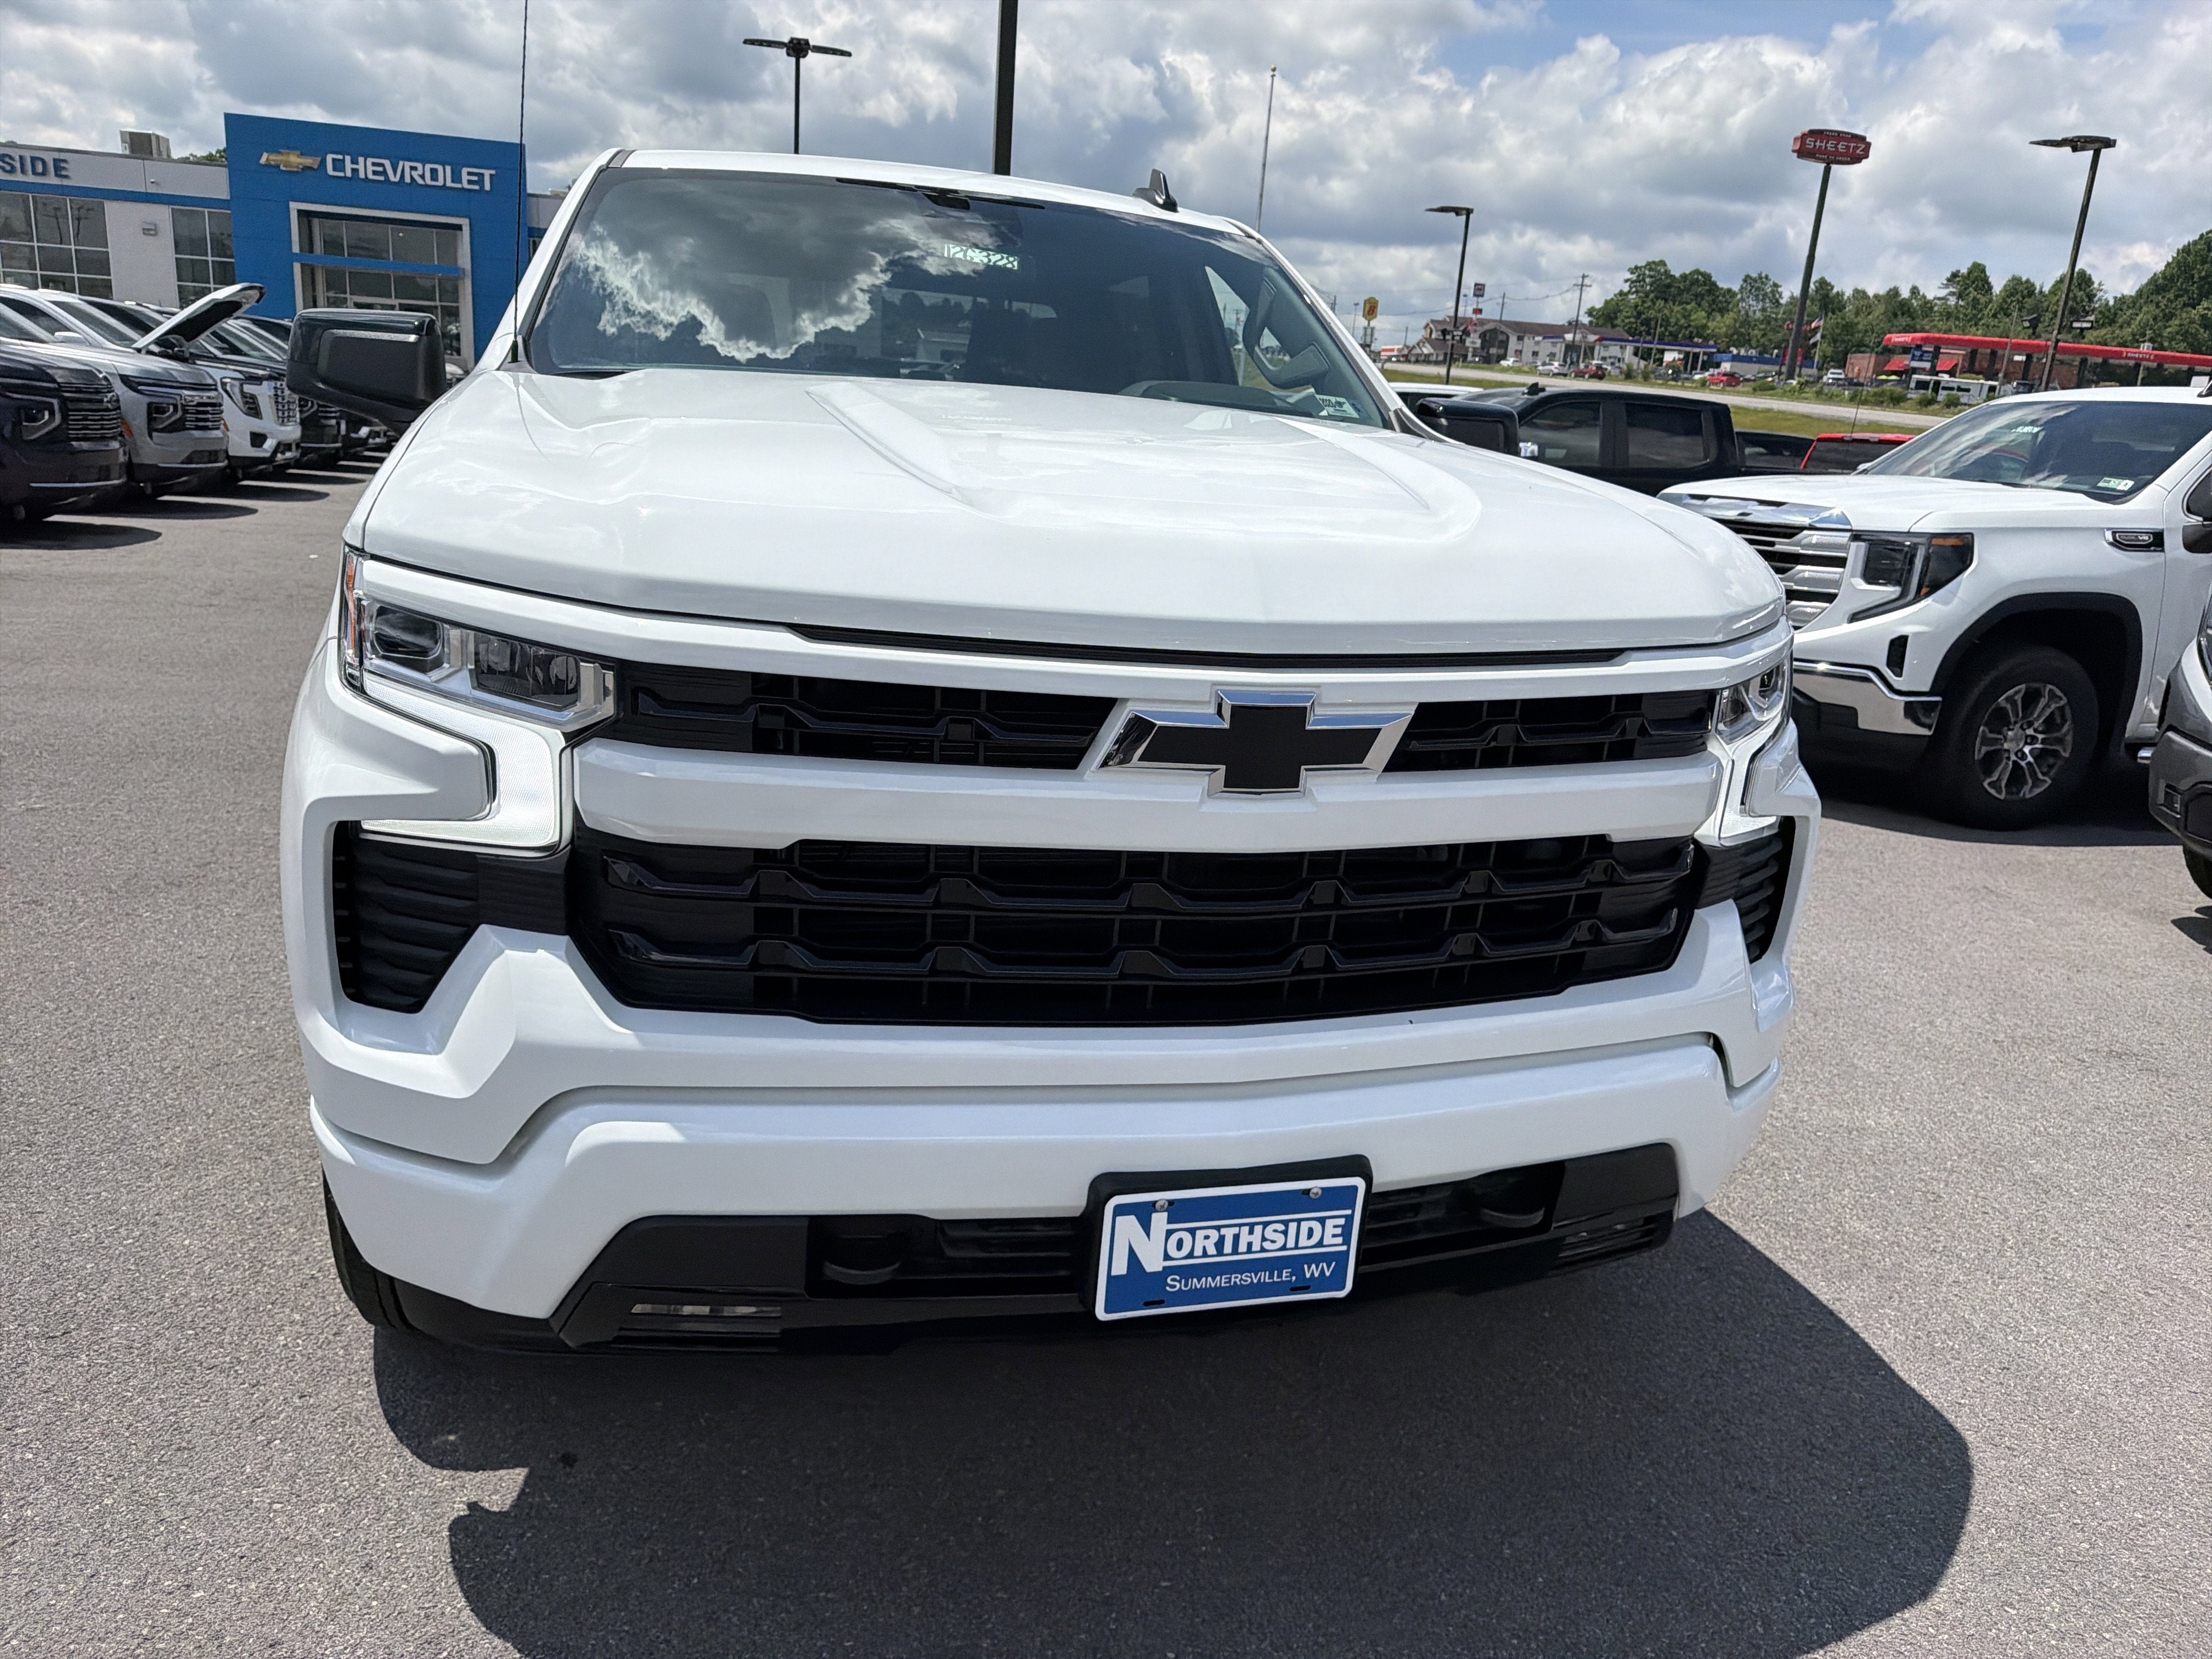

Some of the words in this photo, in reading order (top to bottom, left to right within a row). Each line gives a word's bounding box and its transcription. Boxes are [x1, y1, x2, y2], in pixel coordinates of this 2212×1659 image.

[1805, 137, 1865, 155] SHEETZ
[0, 153, 71, 179] SIDE
[326, 153, 496, 191] CHEVROLET
[1110, 1211, 1346, 1276] NORTHSIDE
[1165, 1268, 1296, 1292] SUMMERSVILLE,
[1304, 1261, 1336, 1279] WV
